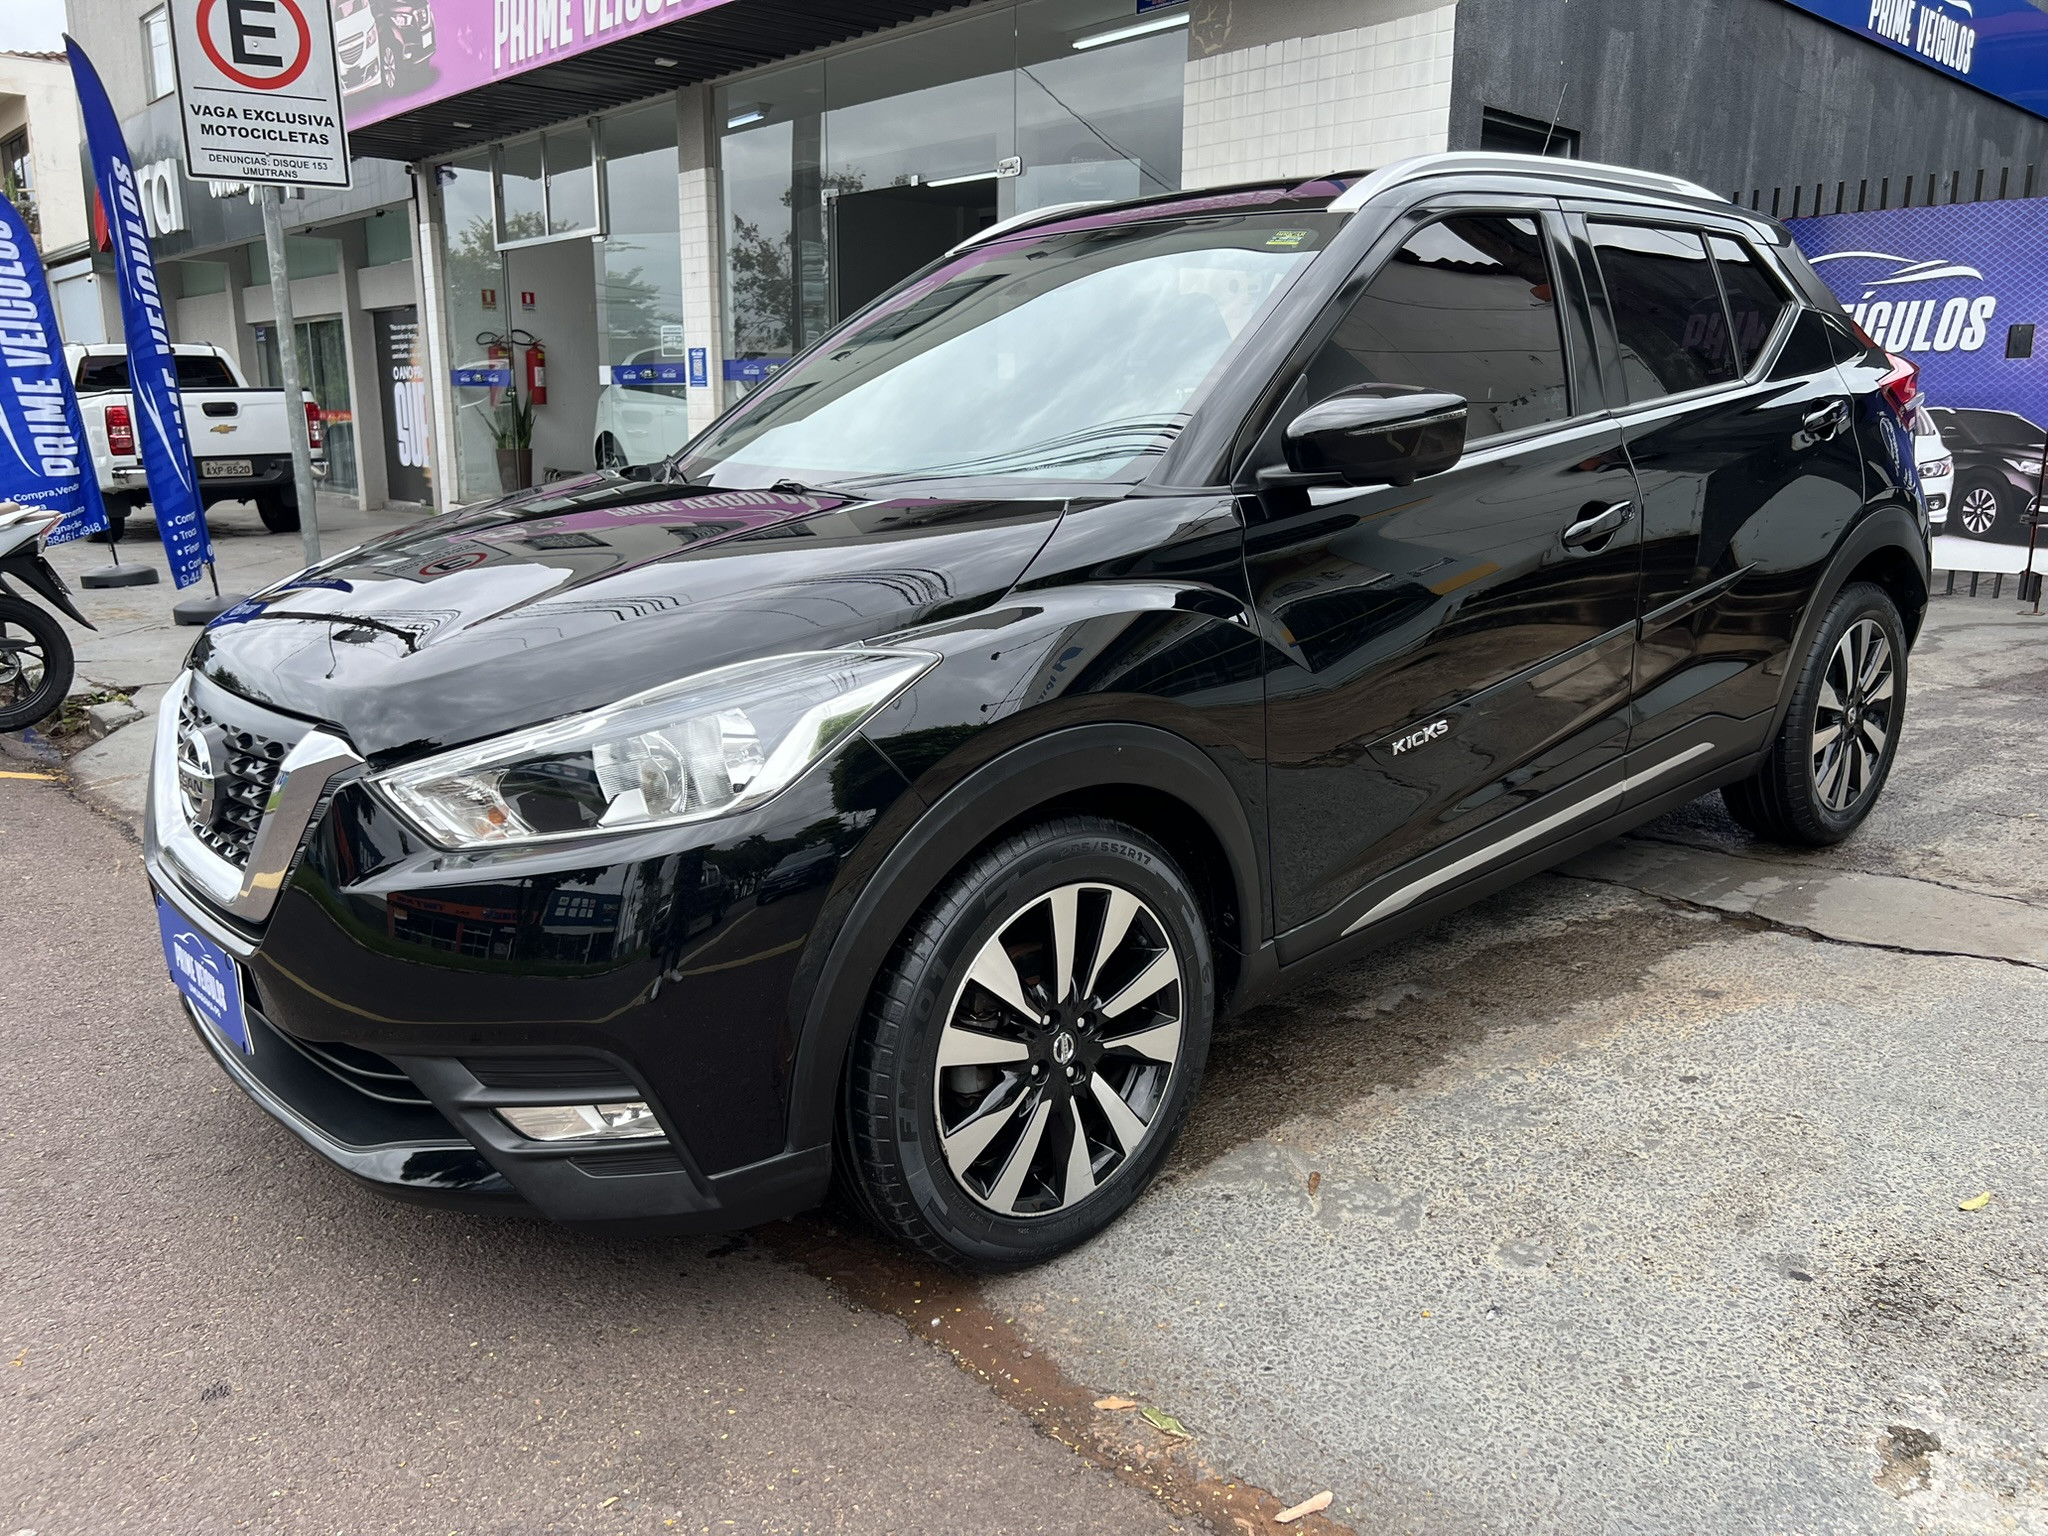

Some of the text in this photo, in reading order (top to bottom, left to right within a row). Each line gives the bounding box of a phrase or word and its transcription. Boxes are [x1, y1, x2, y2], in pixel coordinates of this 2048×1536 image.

[226, 0, 284, 68] E
[1867, 0, 1976, 75] PRIME VEÍCULOS
[190, 104, 335, 128] VAGA EXCLUSIVA
[200, 123, 330, 145] MOTOCICLETAS
[208, 153, 329, 171] DENUNCIAS: DISQUE 153
[242, 167, 299, 179] UMUTRANS
[1841, 291, 1997, 352] ÍCULOS
[12, 376, 81, 477] PRIME
[1391, 719, 1449, 756] KICKS
